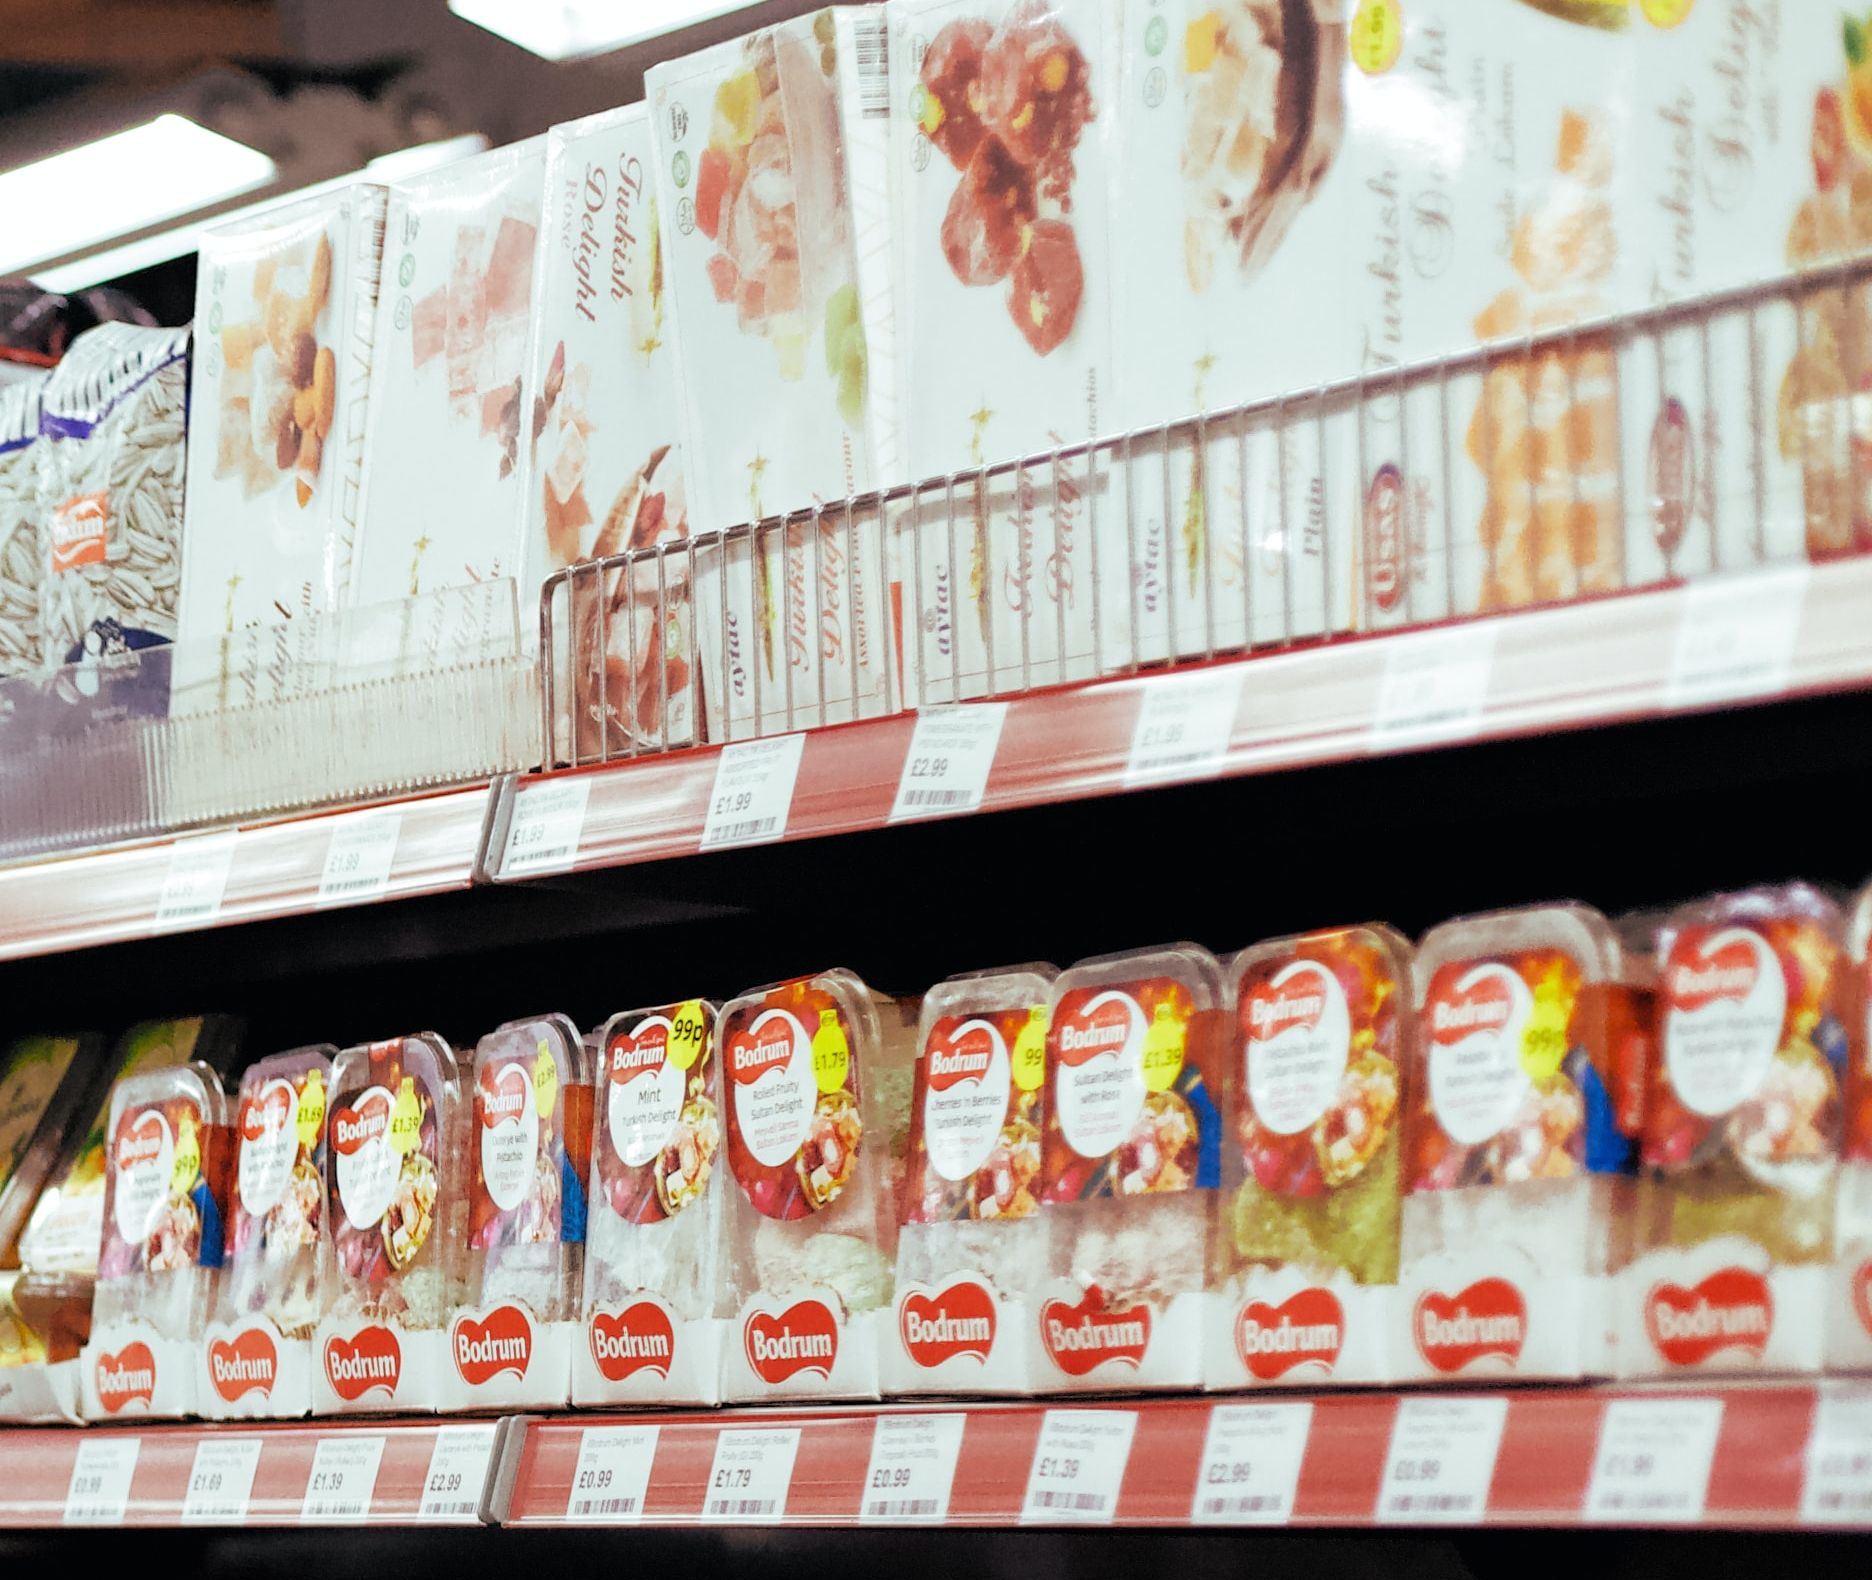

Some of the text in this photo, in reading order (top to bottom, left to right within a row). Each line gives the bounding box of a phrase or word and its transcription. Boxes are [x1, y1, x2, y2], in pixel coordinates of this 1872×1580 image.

[610, 152, 643, 304] Turkish
[574, 162, 607, 323] Delight
[936, 564, 950, 656] aytac
[910, 757, 949, 778] £2.99
[714, 791, 751, 817] £1.99
[1251, 993, 1321, 1025] Bodrum
[673, 1019, 703, 1047] 99p
[1061, 1022, 1126, 1050] Bodrum
[612, 1044, 665, 1071] Bodrum
[735, 1039, 790, 1069] Bodrum
[815, 1052, 846, 1071] £1.79
[930, 1048, 988, 1075] Bodrum
[1025, 1048, 1043, 1066] 99
[484, 1089, 522, 1114] Bodrum
[638, 1088, 661, 1105] Mint
[337, 1113, 385, 1143] Bodrum
[392, 1116, 419, 1133] £1.39
[647, 1109, 677, 1126] Delight
[906, 1308, 991, 1345] Bodrum
[1048, 1311, 1143, 1352] Bodrum
[1243, 1317, 1338, 1354] Bodrum
[1422, 1308, 1521, 1345] Bodrum
[1655, 1303, 1768, 1342] Bodrum
[457, 1331, 527, 1366] Bodrum
[594, 1327, 668, 1360] Bodrum
[752, 1329, 833, 1361] Bodrum
[97, 1361, 153, 1394] Bodrum
[212, 1355, 273, 1384] Bodrum
[329, 1350, 397, 1381] Bodrum
[312, 1471, 344, 1492] £1.39
[578, 1469, 614, 1489] £0.99
[714, 1468, 752, 1489] £1.79
[872, 1468, 911, 1489] £0.99
[1038, 1458, 1080, 1479] £1.39
[429, 1473, 463, 1493] £2.99
